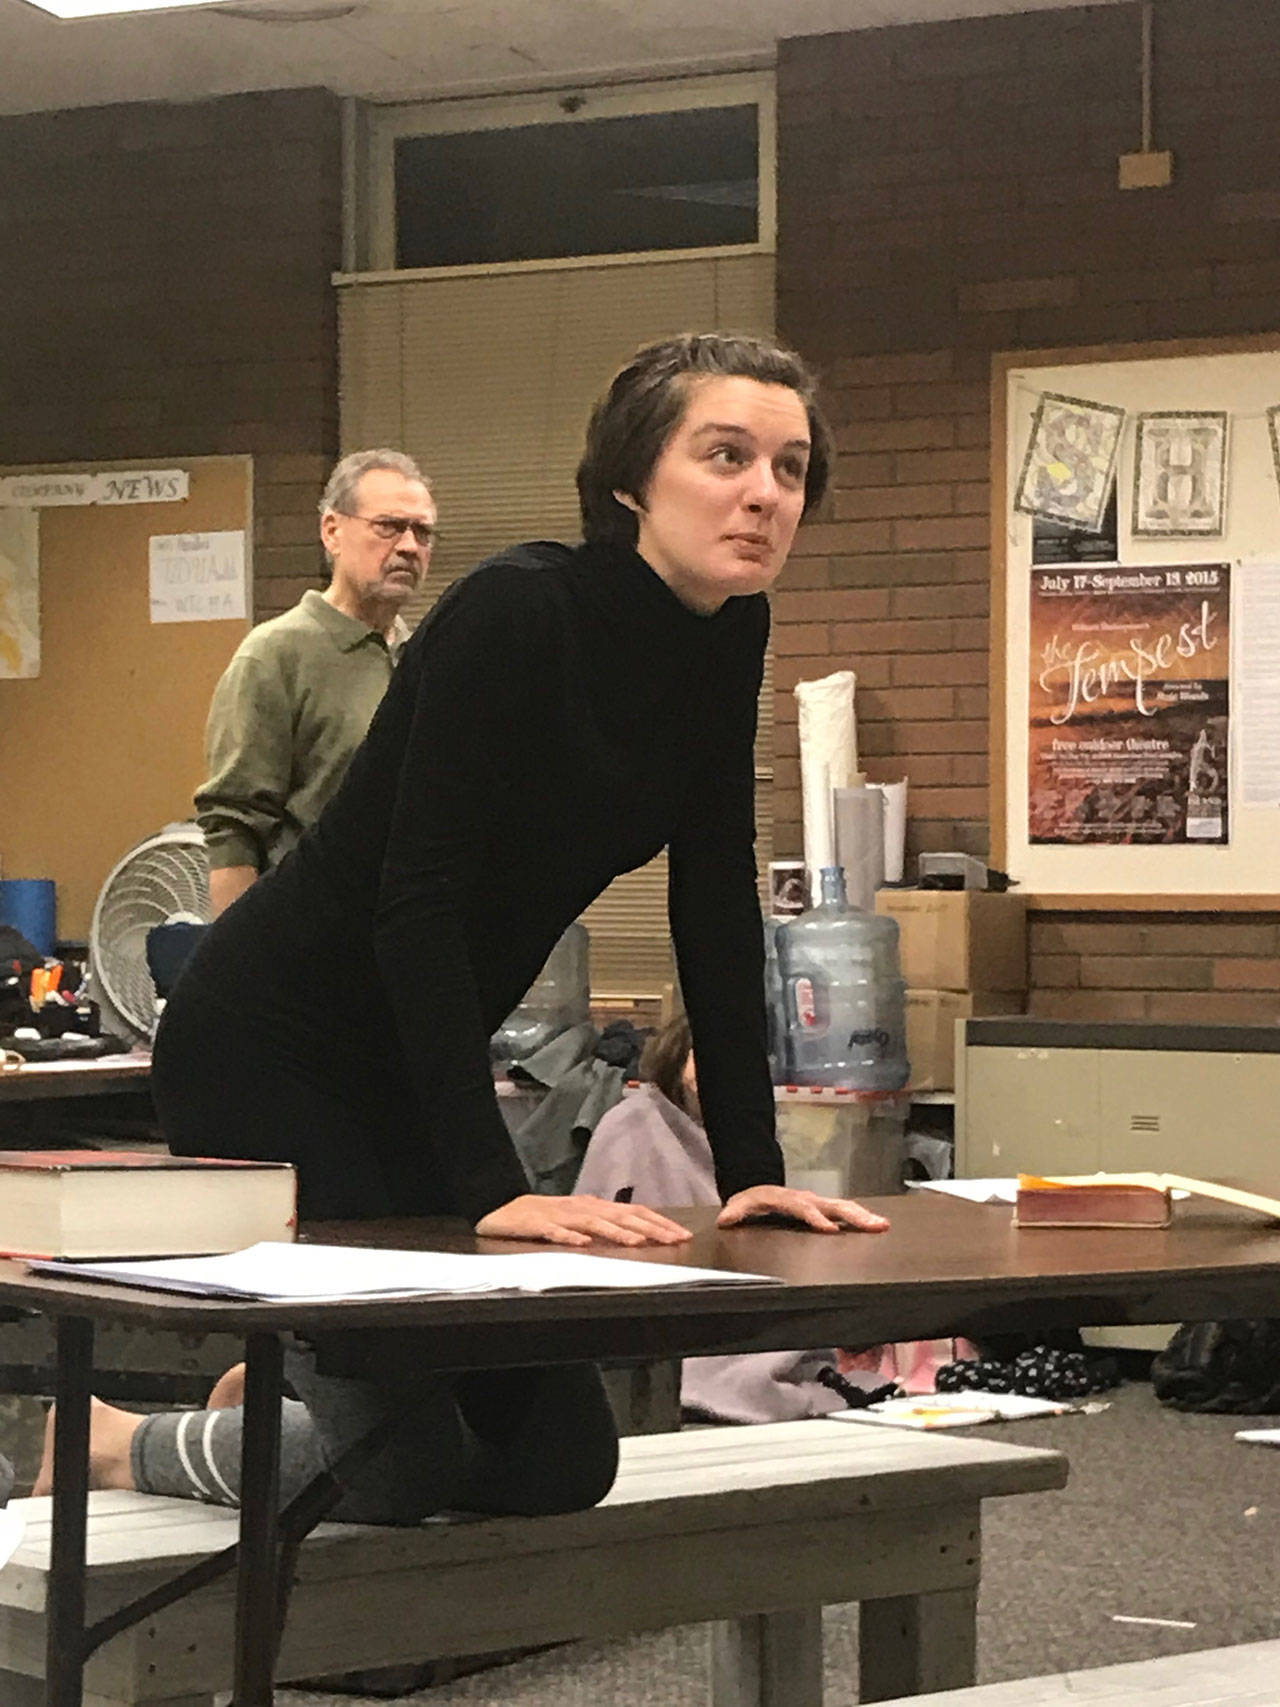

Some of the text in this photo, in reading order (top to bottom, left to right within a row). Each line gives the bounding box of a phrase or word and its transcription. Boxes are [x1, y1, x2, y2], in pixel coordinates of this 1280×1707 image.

[103, 476, 180, 500] NEWS
[1040, 575, 1070, 592] July
[1185, 570, 1218, 585] 2015
